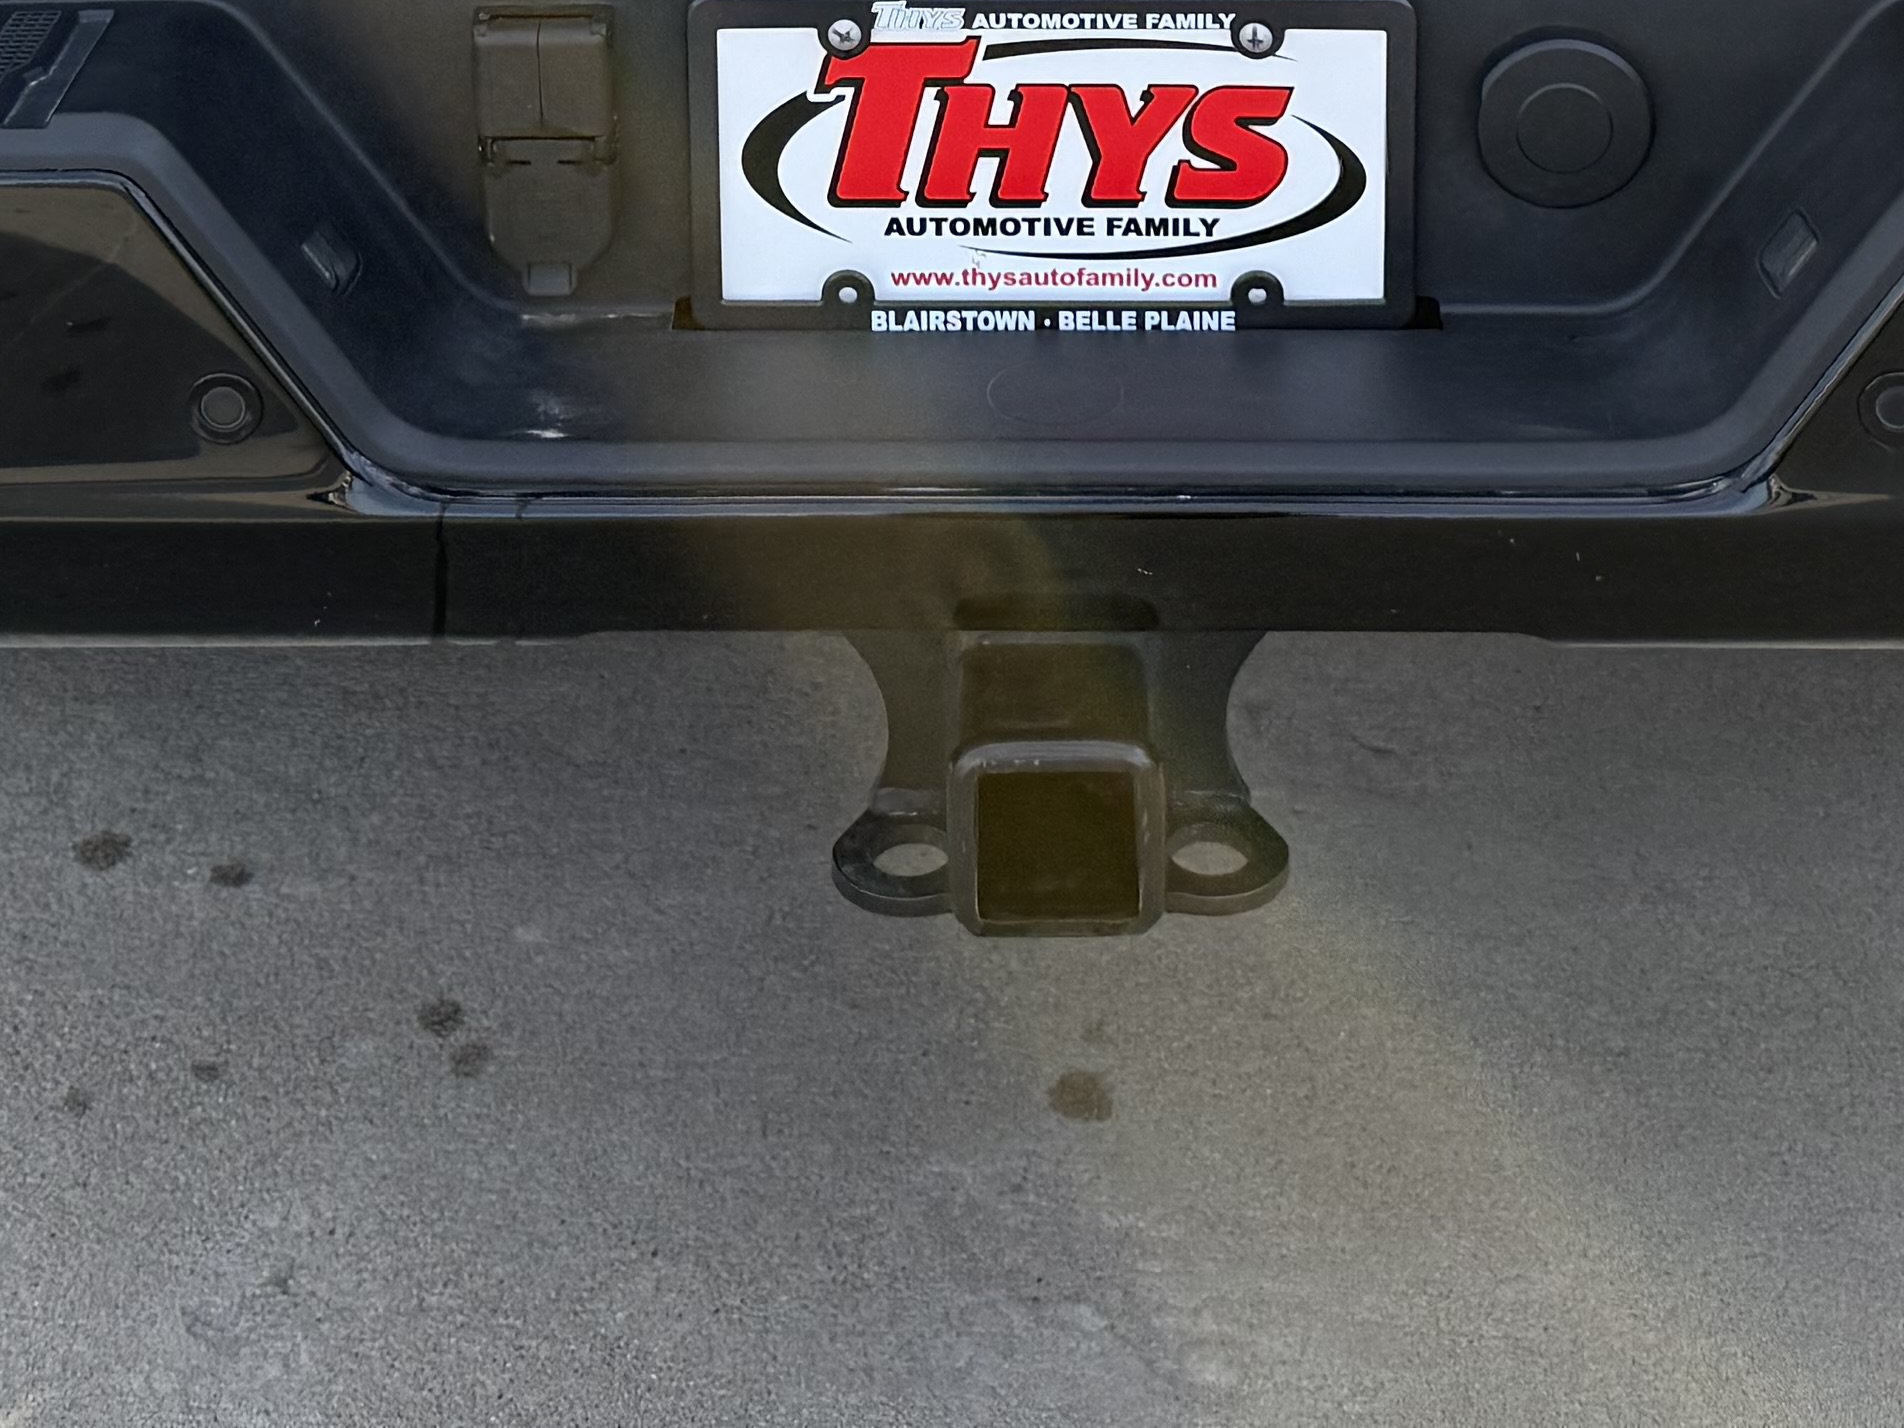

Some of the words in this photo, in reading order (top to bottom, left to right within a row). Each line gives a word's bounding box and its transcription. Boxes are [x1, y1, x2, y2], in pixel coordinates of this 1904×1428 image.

[972, 12, 1138, 30] AUTOMOTIVE
[1146, 12, 1237, 30] FAMILY
[814, 35, 1296, 210] THYS
[884, 217, 1096, 237] AUTOMOTIVE
[1106, 217, 1221, 237] FAMILY
[891, 267, 1218, 292] www.thysautofamily.com
[871, 310, 1036, 332] BLAIRSTOWN
[1058, 310, 1138, 332] BELLE
[1144, 310, 1237, 332] PLAINE
